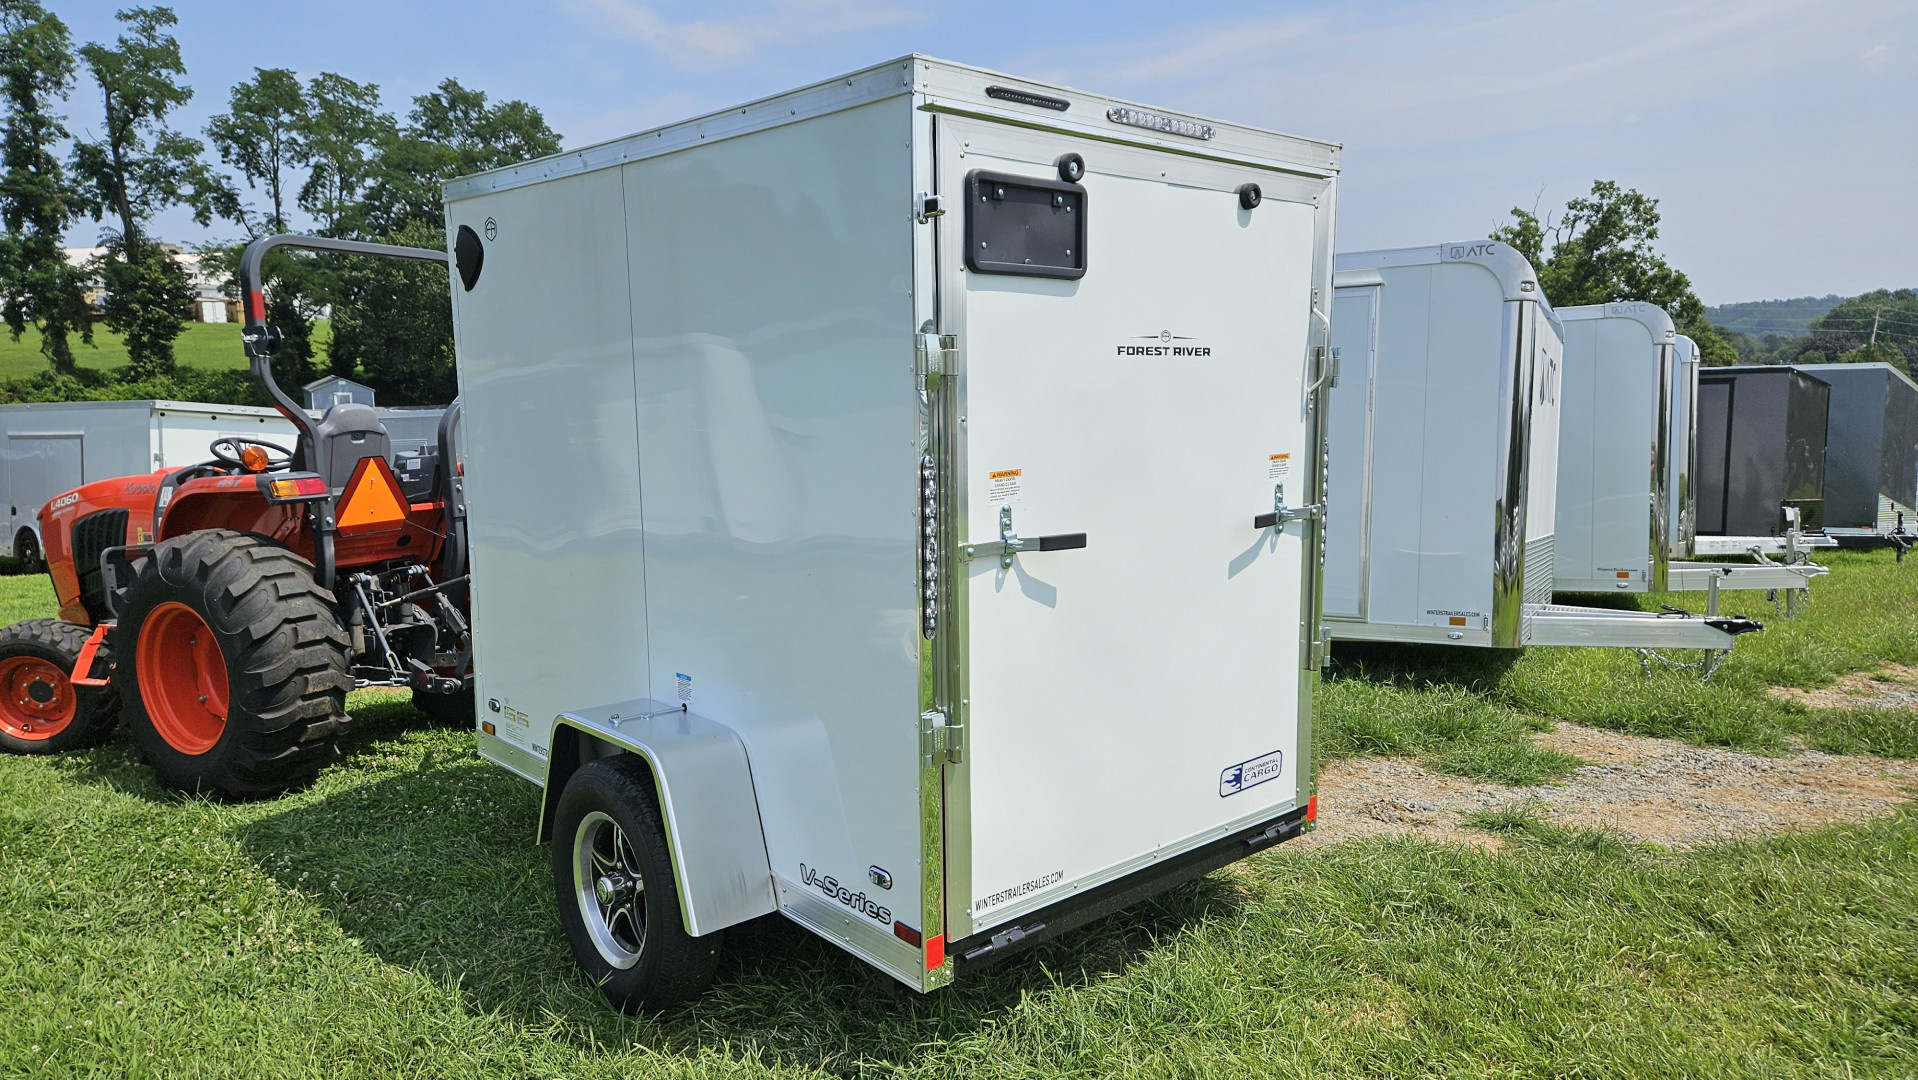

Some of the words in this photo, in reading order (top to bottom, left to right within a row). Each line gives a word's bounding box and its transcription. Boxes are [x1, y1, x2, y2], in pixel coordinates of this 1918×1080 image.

[1467, 244, 1495, 257] ATC
[1624, 304, 1646, 315] ATC
[1117, 345, 1170, 356] FOREST
[1173, 347, 1211, 356] RIVER
[997, 470, 1018, 478] WARNING
[125, 482, 157, 495] Kubota
[51, 492, 79, 511] L4060
[1426, 609, 1480, 617] WINTERSTRAILERSALES.COM
[1243, 763, 1278, 782] CARGO
[1244, 758, 1278, 774] CONTINENTAL
[800, 862, 892, 925] V-Series
[975, 869, 1064, 912] WINTERSTRAILERSALES.COM
